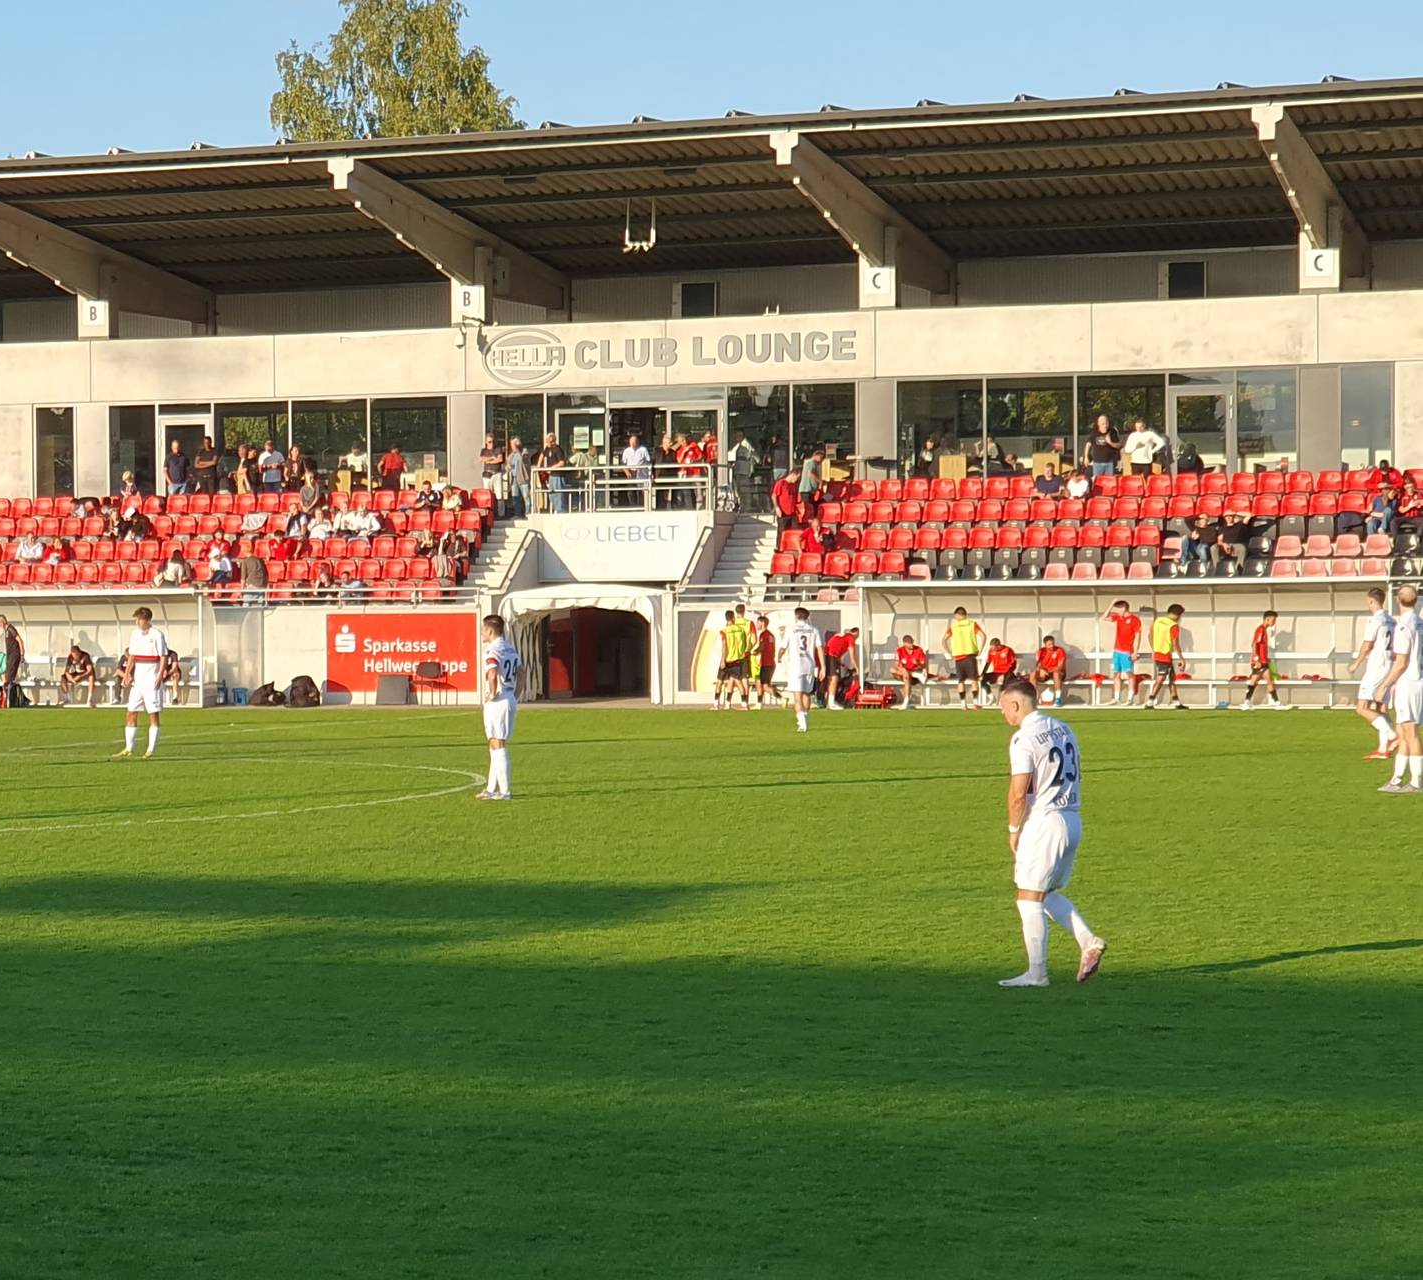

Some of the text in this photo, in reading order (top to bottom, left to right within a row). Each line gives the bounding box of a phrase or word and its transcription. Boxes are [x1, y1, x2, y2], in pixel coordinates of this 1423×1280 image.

[1313, 254, 1324, 272] C
[872, 272, 881, 289] C
[463, 291, 471, 307] B
[89, 306, 98, 321] B
[491, 346, 566, 367] HELLA
[574, 330, 857, 370] CLUB LOUNGE
[595, 525, 680, 543] LIEBELT
[363, 637, 437, 656] Sparkasse
[799, 635, 808, 651] 3
[1048, 741, 1077, 787] 23
